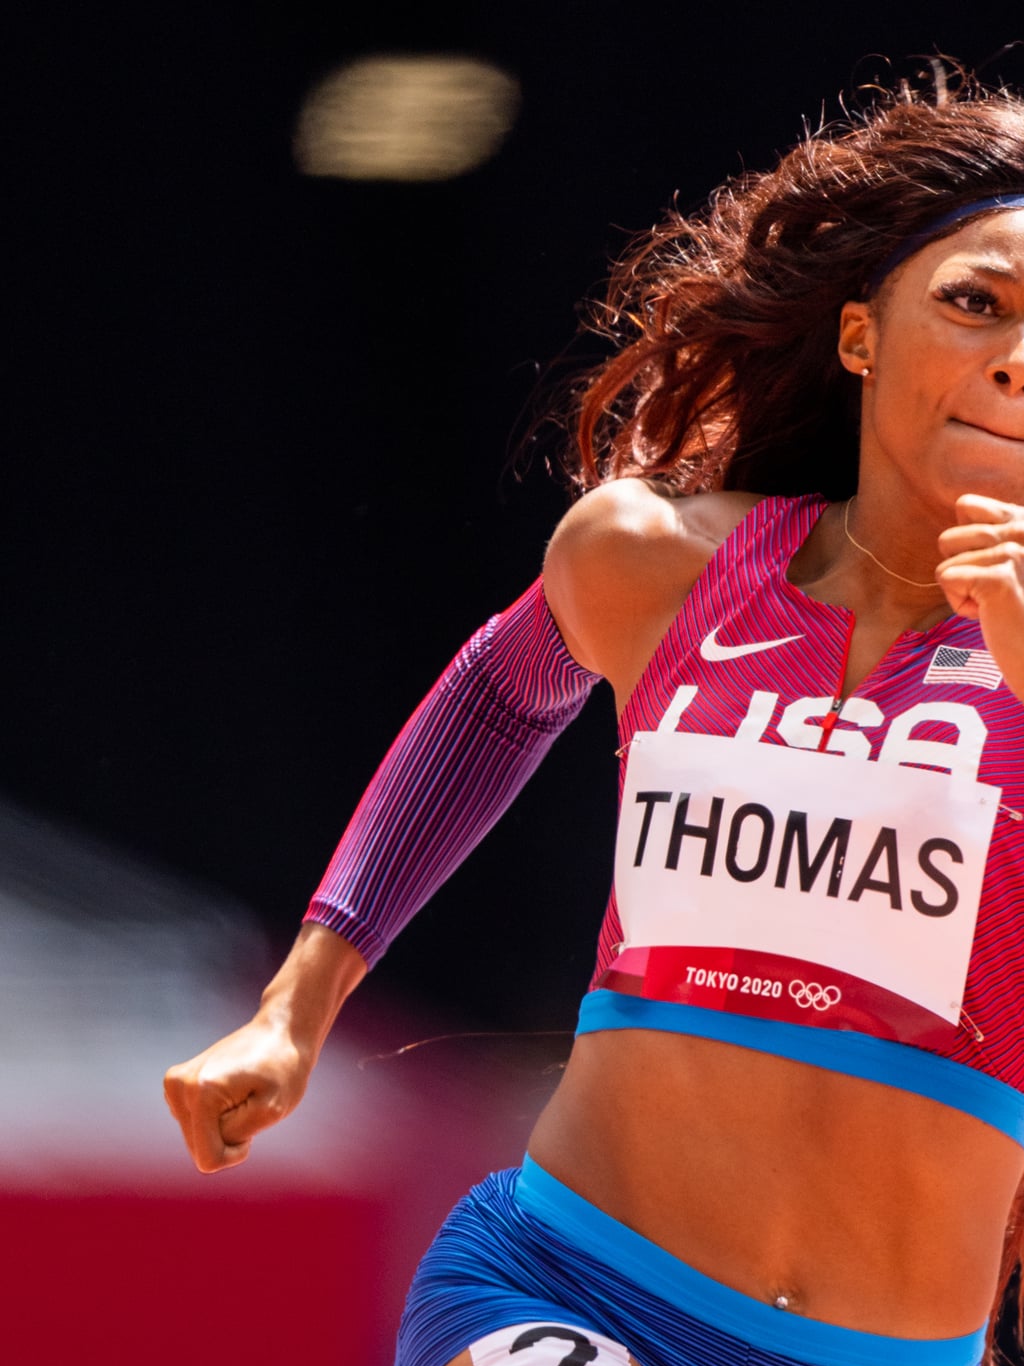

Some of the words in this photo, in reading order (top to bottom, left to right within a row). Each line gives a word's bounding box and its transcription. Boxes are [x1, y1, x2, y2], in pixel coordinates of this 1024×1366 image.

[633, 790, 965, 918] THOMAS
[685, 966, 738, 991] TOKYO
[740, 976, 783, 998] 2020
